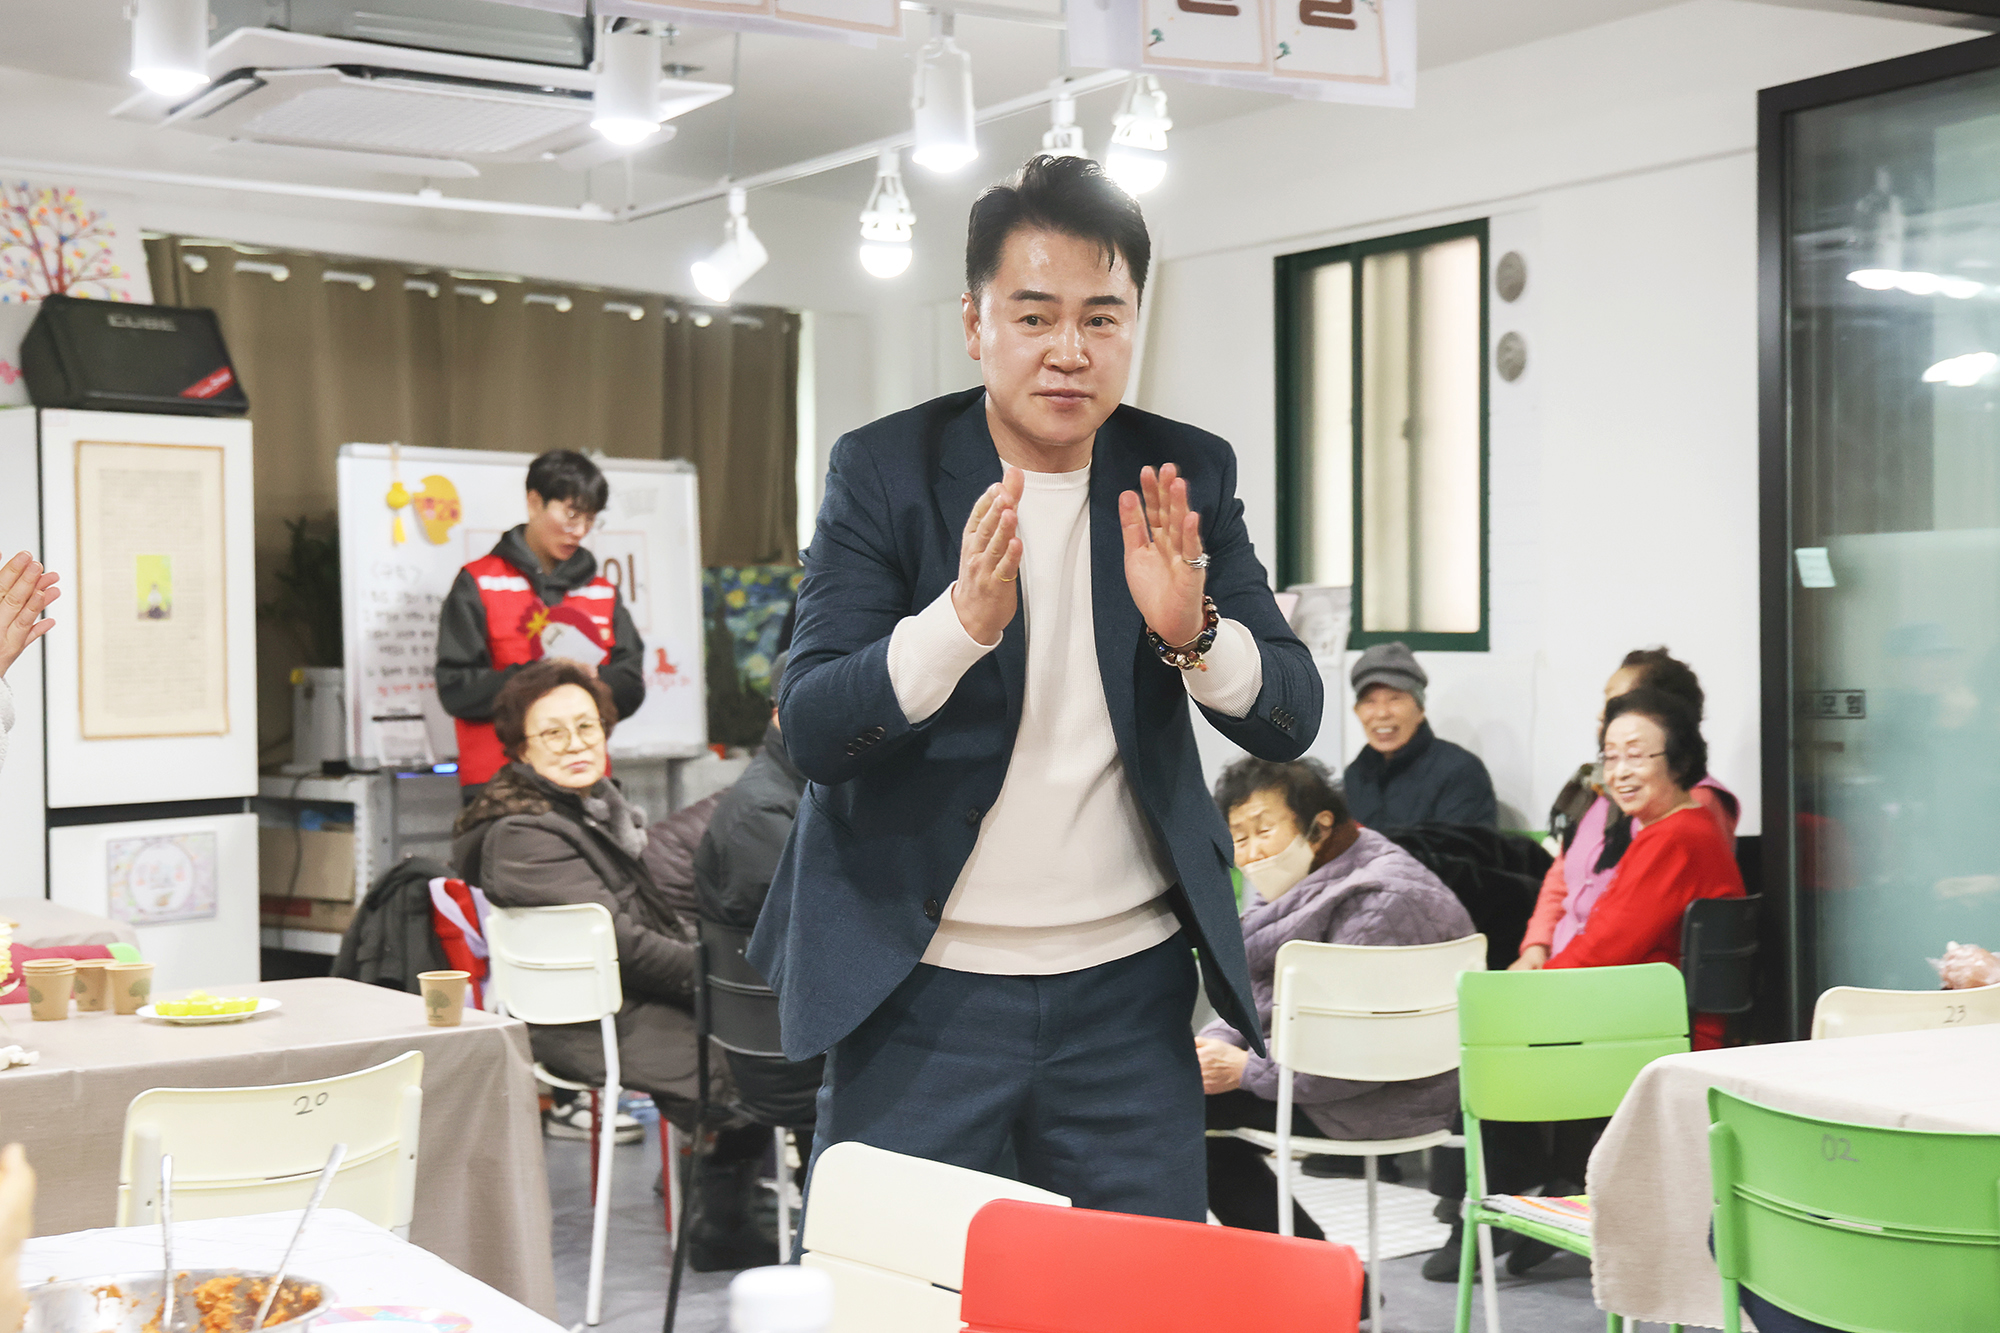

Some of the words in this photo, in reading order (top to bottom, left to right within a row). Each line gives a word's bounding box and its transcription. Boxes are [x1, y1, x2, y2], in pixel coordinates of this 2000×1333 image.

[1943, 1004, 1967, 1024] 23
[293, 1091, 329, 1116] 20
[1821, 1134, 1859, 1162] 02
